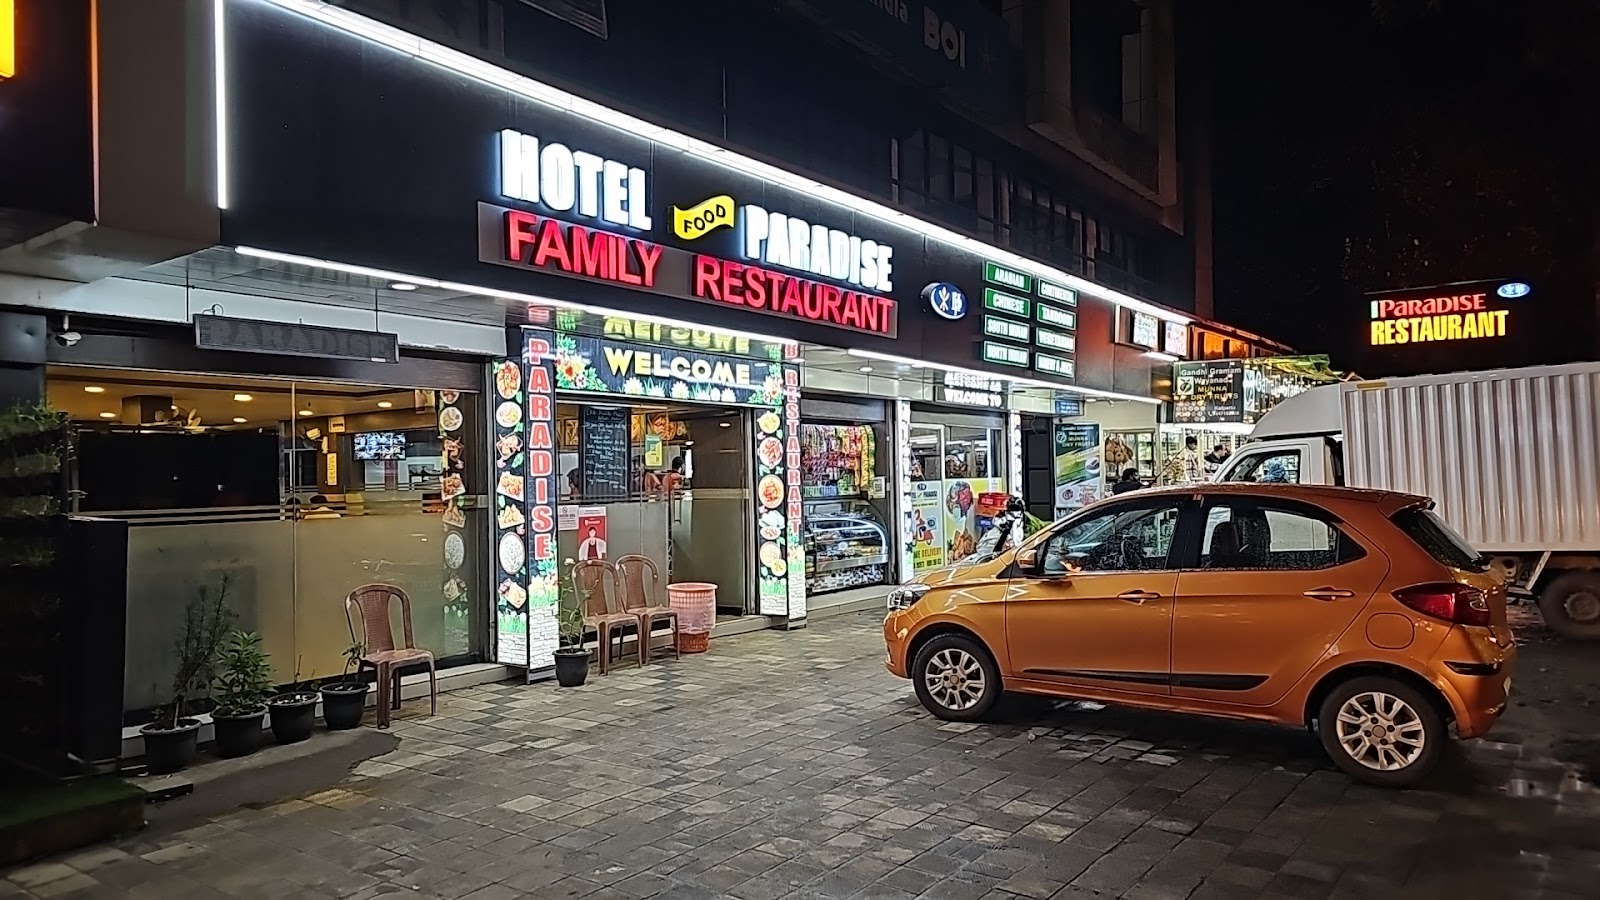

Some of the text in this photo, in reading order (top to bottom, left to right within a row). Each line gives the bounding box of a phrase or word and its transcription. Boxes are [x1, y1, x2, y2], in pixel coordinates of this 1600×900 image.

[923, 5, 966, 69] BOI
[500, 129, 893, 292] HOTEL PARADISE
[682, 202, 727, 234] FOOD
[506, 209, 895, 333] FAMILY RESTAURANT
[994, 267, 1025, 289] ARABIAN
[992, 293, 1025, 314] CHINESE
[208, 320, 390, 357] PARADISE
[987, 318, 1008, 335] SOUTH
[1370, 310, 1509, 345] RESTAURANT
[602, 346, 751, 385] WELCOME
[986, 343, 1007, 361] NORTH
[1181, 366, 1242, 376] Gandhi Gramam
[1194, 376, 1229, 386] Wayanad
[944, 388, 1002, 407] WELCOME TO
[1190, 393, 1208, 401] DRY
[1197, 385, 1228, 393] MUNNA
[527, 338, 554, 561] PARADISE
[784, 368, 803, 534] RESTAURANT
